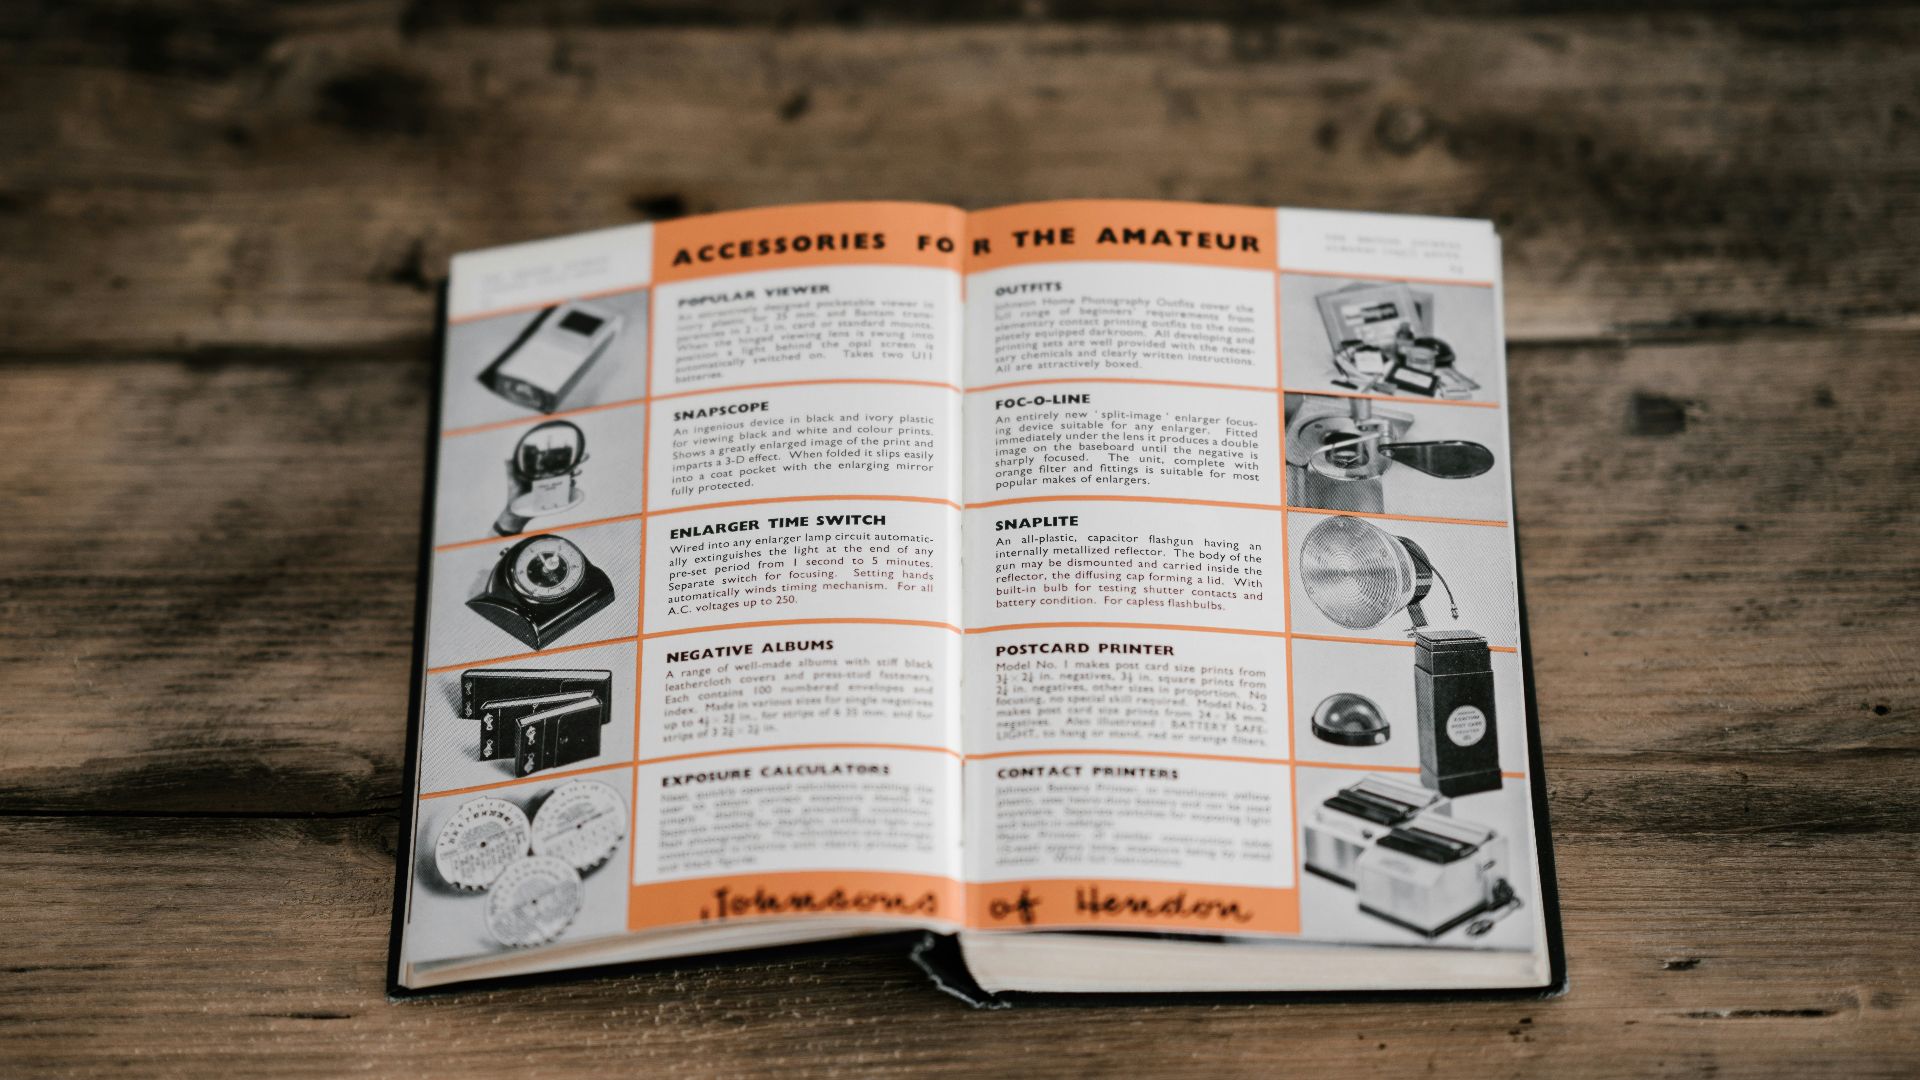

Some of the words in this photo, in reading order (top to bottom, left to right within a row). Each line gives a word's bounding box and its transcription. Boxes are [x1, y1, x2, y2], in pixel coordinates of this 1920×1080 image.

[672, 232, 886, 267] ACCESSORIES
[1012, 227, 1076, 249] THE
[1096, 227, 1261, 252] AMATEUR
[677, 290, 755, 307] POPULAR
[764, 284, 830, 297] VIEWER
[994, 282, 1062, 296] OUTFITS
[673, 402, 768, 421] SNAPSCOPE
[995, 394, 1090, 410] FOC-O-LINE
[994, 454, 1034, 468] sharply
[1043, 452, 1088, 463] focused.
[1107, 452, 1129, 462] The
[1138, 454, 1164, 467] unit,
[1173, 457, 1224, 469] complete
[1234, 461, 1258, 471] with
[671, 474, 693, 485] into
[710, 468, 733, 479] coat
[738, 464, 776, 478] pocket
[782, 461, 807, 472] with
[813, 460, 831, 471] the
[837, 460, 889, 473] enlarging
[896, 462, 933, 472] mirror
[994, 468, 1032, 478] orange
[1038, 464, 1067, 474] filter
[1072, 463, 1092, 473] and
[1099, 463, 1138, 476] fittings
[1145, 465, 1154, 474] is
[1160, 466, 1203, 477] suitable
[1209, 468, 1226, 479] for
[1232, 473, 1259, 482] most
[671, 484, 694, 496] fully
[697, 478, 753, 495] protected.
[995, 476, 1037, 492] popular
[1042, 474, 1076, 484] makes
[1080, 474, 1092, 484] of
[1095, 474, 1150, 487] enlargers.
[669, 520, 759, 540] ENLARGER
[767, 516, 808, 529] TIME
[816, 514, 885, 526] SWITCH
[995, 516, 1078, 531] SNAPLITE
[669, 541, 704, 555] Wired
[707, 540, 729, 550] into
[732, 540, 751, 549] any
[754, 535, 801, 546] enlarger
[804, 532, 831, 544] lamp
[834, 532, 871, 541] circuit
[874, 533, 933, 544] automatic-
[995, 536, 1011, 546] An
[1021, 533, 1077, 546] all-plastic,
[1087, 533, 1138, 545] capacitor
[1148, 534, 1193, 548] flashgun
[1204, 537, 1239, 552] having
[668, 556, 687, 568] ally
[694, 548, 761, 564] extinguishes
[768, 546, 786, 556] the
[794, 544, 818, 557] light
[826, 544, 836, 554] at
[843, 543, 862, 553] the
[869, 543, 889, 554] end
[896, 544, 908, 554] of
[914, 548, 933, 558] any
[995, 546, 1048, 558] internally
[1052, 545, 1109, 555] metallized
[1114, 545, 1165, 557] reflector.
[1173, 548, 1194, 558] The
[1198, 549, 1225, 563] body
[1229, 552, 1240, 562] of
[1243, 553, 1261, 564] the
[669, 567, 706, 582] pre-set
[714, 561, 750, 576] period
[757, 560, 784, 570] from
[805, 556, 844, 567] second
[851, 557, 864, 566] to
[871, 556, 878, 566] 5
[886, 557, 933, 568] minutes.
[995, 563, 1015, 574] gun
[1021, 561, 1043, 571] may
[1048, 558, 1061, 568] be
[1066, 557, 1132, 568] dismounted
[1137, 559, 1157, 569] and
[1162, 561, 1201, 572] carried
[1207, 563, 1239, 574] inside
[1243, 566, 1262, 576] the
[668, 578, 714, 593] Separate
[721, 572, 756, 585] switch
[764, 571, 781, 581] for
[788, 569, 837, 581] focusing.
[853, 568, 893, 581] Setting
[902, 569, 933, 580] hands
[995, 572, 1047, 584] reflector,
[1051, 570, 1070, 580] the
[1074, 570, 1121, 583] diffusing
[1125, 574, 1144, 584] cap
[1148, 571, 1192, 586] forming
[1207, 575, 1224, 586] lid.
[1233, 577, 1262, 589] With
[667, 586, 739, 604] automatically
[744, 583, 776, 595] winds
[781, 582, 816, 593] timing
[822, 580, 887, 590] mechanism.
[897, 581, 915, 592] For
[920, 582, 932, 593] all
[995, 584, 1036, 596] built-in
[1043, 582, 1068, 593] bulb
[1074, 582, 1091, 592] for
[1098, 583, 1136, 596] testing
[1143, 584, 1184, 596] shutter
[1191, 589, 1236, 599] contacts
[1243, 591, 1262, 601] and
[667, 604, 691, 616] A.C.
[695, 602, 739, 613] voltages
[743, 600, 756, 610] up
[760, 597, 772, 606] to
[775, 594, 797, 605] 250.
[995, 598, 1036, 609] battery
[1039, 595, 1096, 606] condition.
[1103, 595, 1123, 605] For
[1125, 596, 1164, 609] capless
[1167, 597, 1225, 611] flashbulbs.
[666, 645, 752, 663] NEGATIVE
[761, 640, 833, 653] ALBUMS
[995, 643, 1089, 656] POSTCARD
[1098, 643, 1174, 656] PRINTER
[680, 668, 711, 678] range
[716, 663, 729, 674] of
[661, 769, 751, 787] EXPOSURE
[759, 765, 889, 777] CALCULATORS
[996, 766, 1082, 779] CONTACT
[1091, 766, 1178, 779] PRINTERS
[989, 886, 1043, 925] of
[1075, 885, 1254, 923] Hendon
